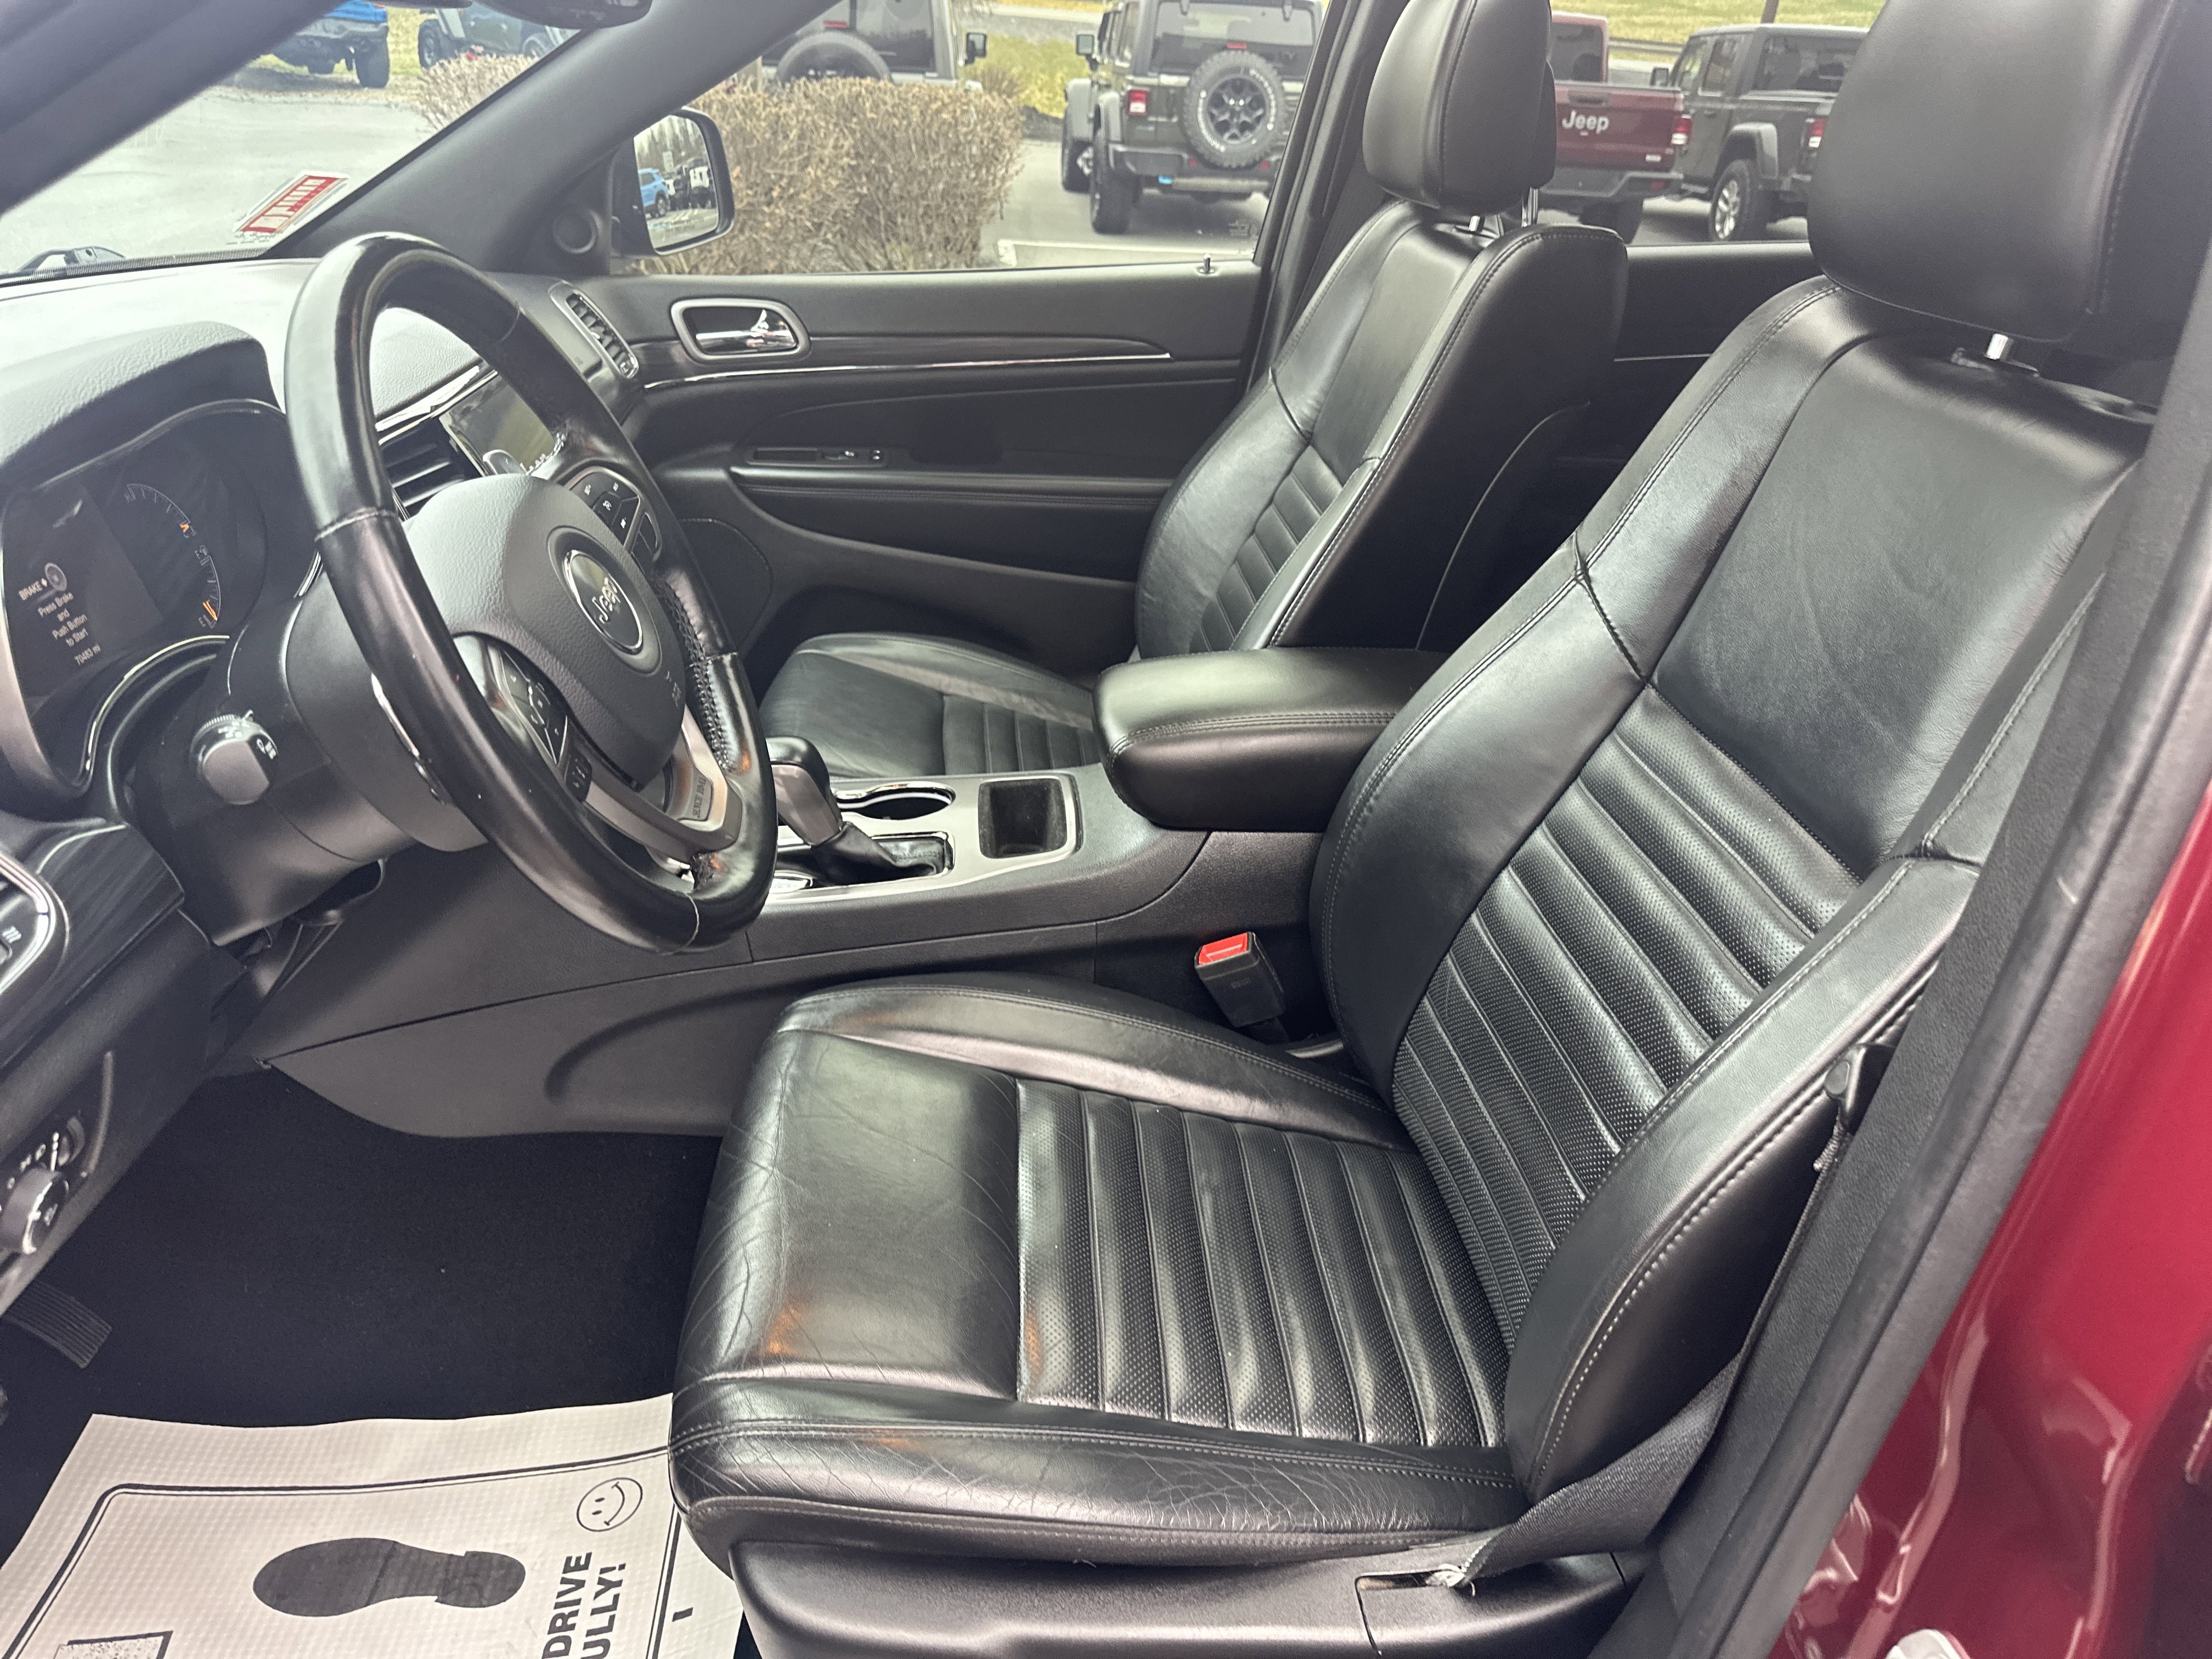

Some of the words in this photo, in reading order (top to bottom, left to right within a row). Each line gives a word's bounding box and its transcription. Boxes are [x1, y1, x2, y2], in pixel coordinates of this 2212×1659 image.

[1562, 109, 1610, 135] Jeep
[18, 581, 43, 601] BRAKE
[592, 577, 621, 624] Jeep
[38, 602, 57, 618] Press
[55, 591, 74, 607] Brake
[57, 608, 70, 622] and
[52, 625, 70, 640] Push
[66, 614, 88, 631] Button
[541, 1551, 592, 1659] DRIVE
